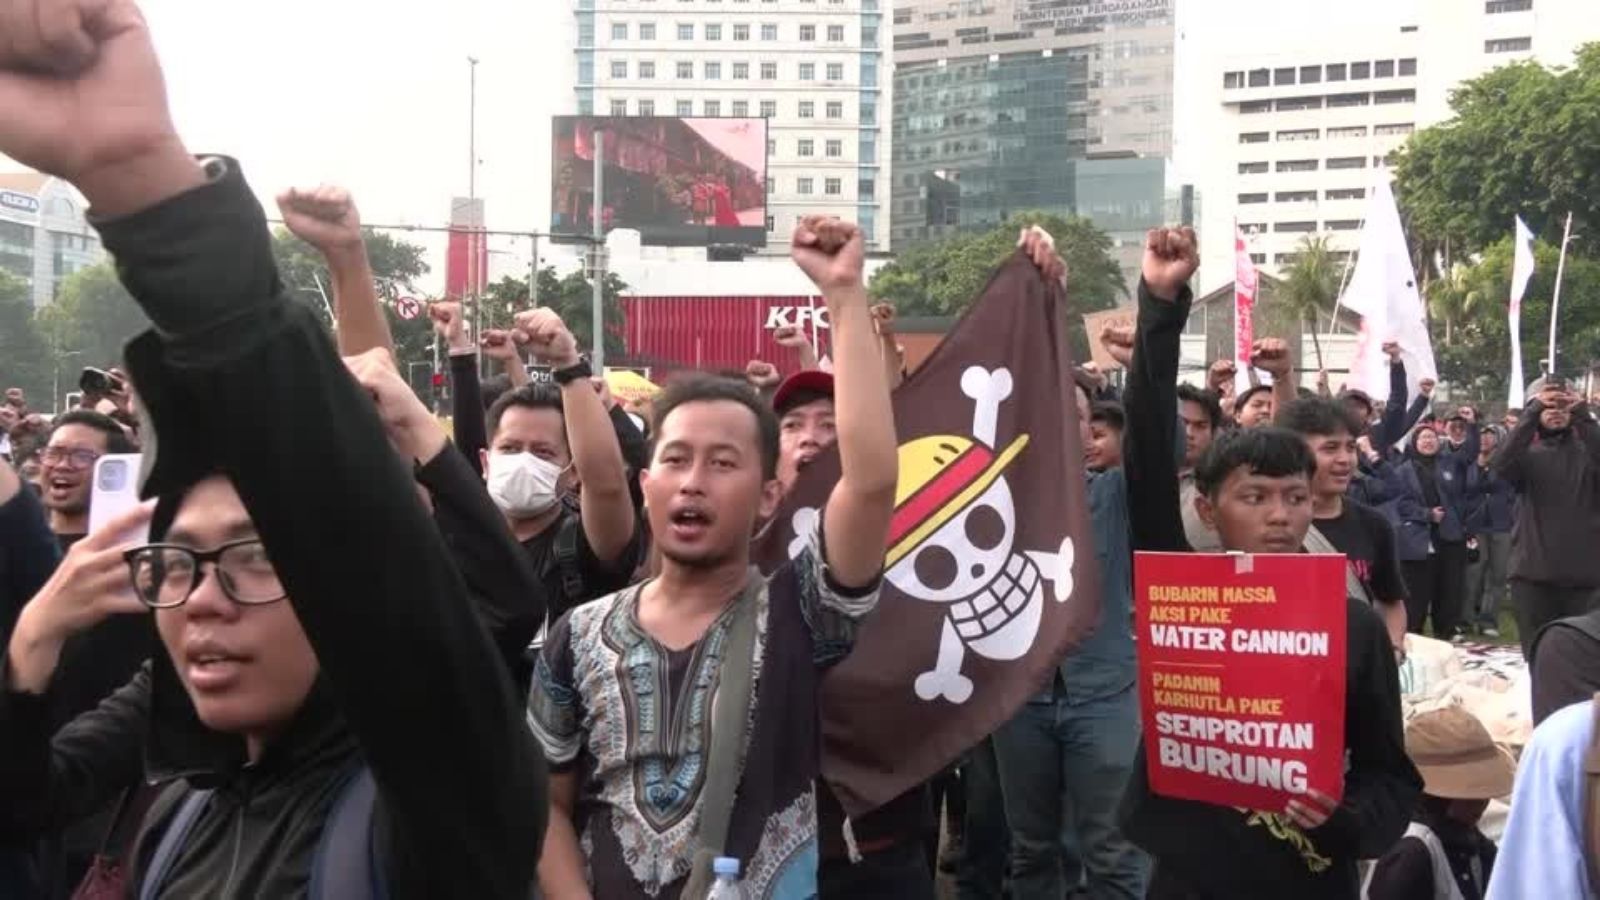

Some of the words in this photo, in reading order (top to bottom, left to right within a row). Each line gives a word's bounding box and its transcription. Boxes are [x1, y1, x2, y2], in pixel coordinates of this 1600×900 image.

[764, 306, 829, 328] KFC
[1148, 586, 1219, 603] BUBARIN
[1223, 586, 1277, 603] MASSA
[1149, 606, 1186, 622] AKSI
[1189, 607, 1231, 624] PAKE
[1150, 624, 1226, 652] WATER
[1231, 628, 1328, 656] CANNON
[1152, 672, 1221, 693] PADAMIN
[1153, 689, 1236, 713] KARHUTLA
[1239, 698, 1283, 716] PAKE
[1156, 711, 1314, 750] SEMPROTAN
[1159, 737, 1308, 795] BURUNG
